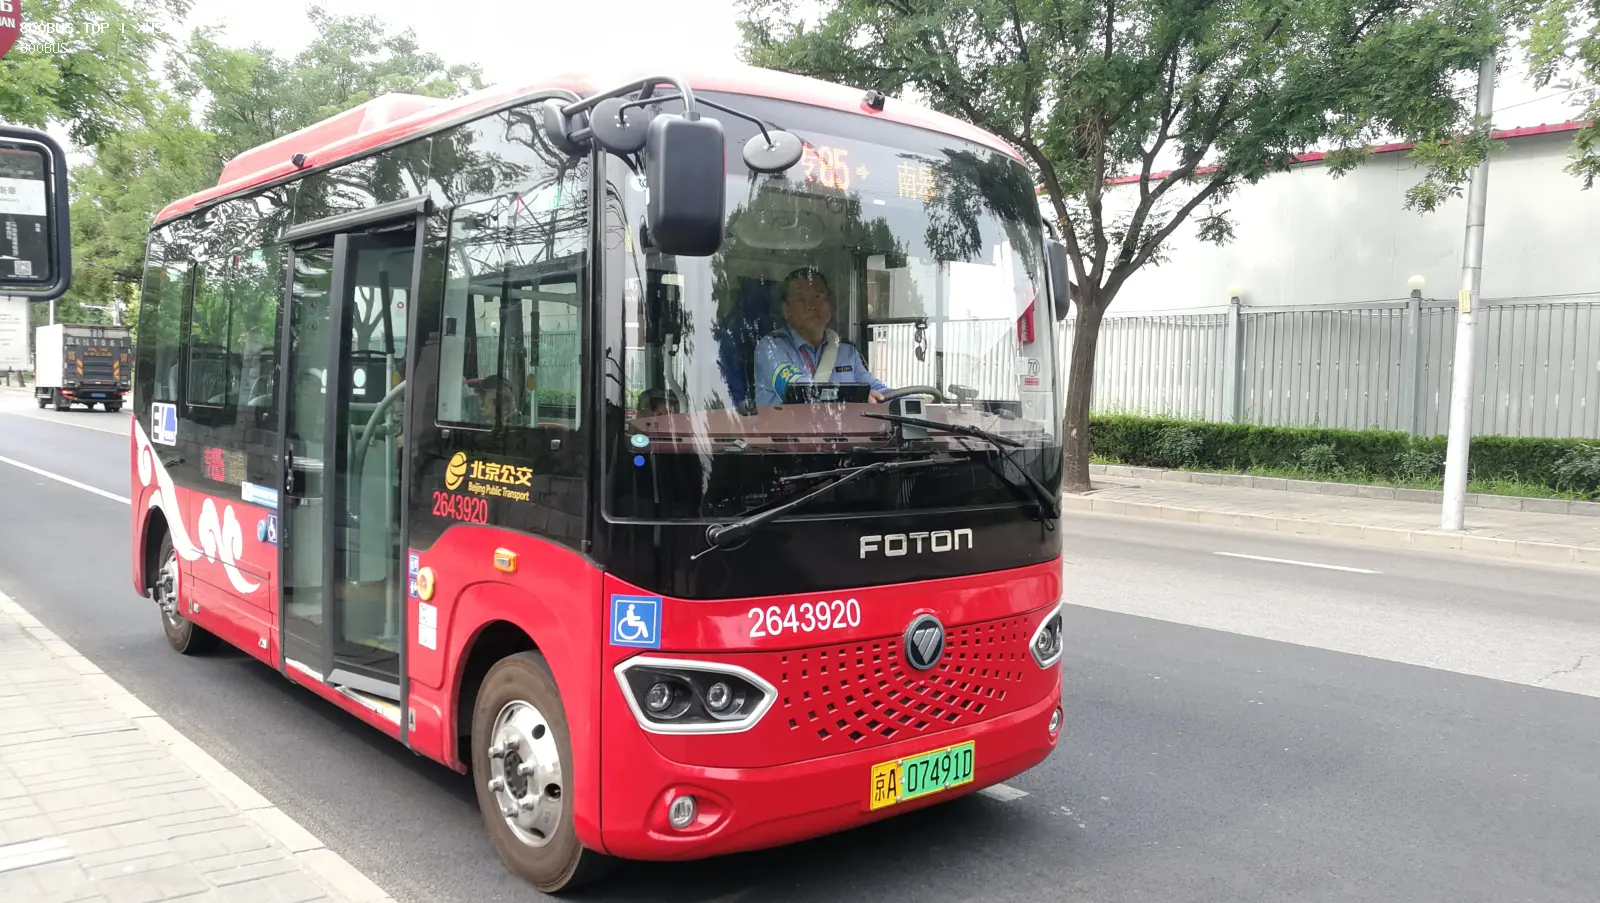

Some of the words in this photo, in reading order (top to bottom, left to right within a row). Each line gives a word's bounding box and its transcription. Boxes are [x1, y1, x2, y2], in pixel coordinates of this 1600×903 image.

[469, 460, 533, 487] 北京公交
[467, 481, 486, 496] Beijing
[485, 483, 502, 497] Public
[502, 487, 530, 502] Transport
[432, 491, 489, 525] 2643920
[859, 528, 973, 559] FOTON
[747, 598, 861, 638] 2643920
[907, 749, 973, 793] 07491D
